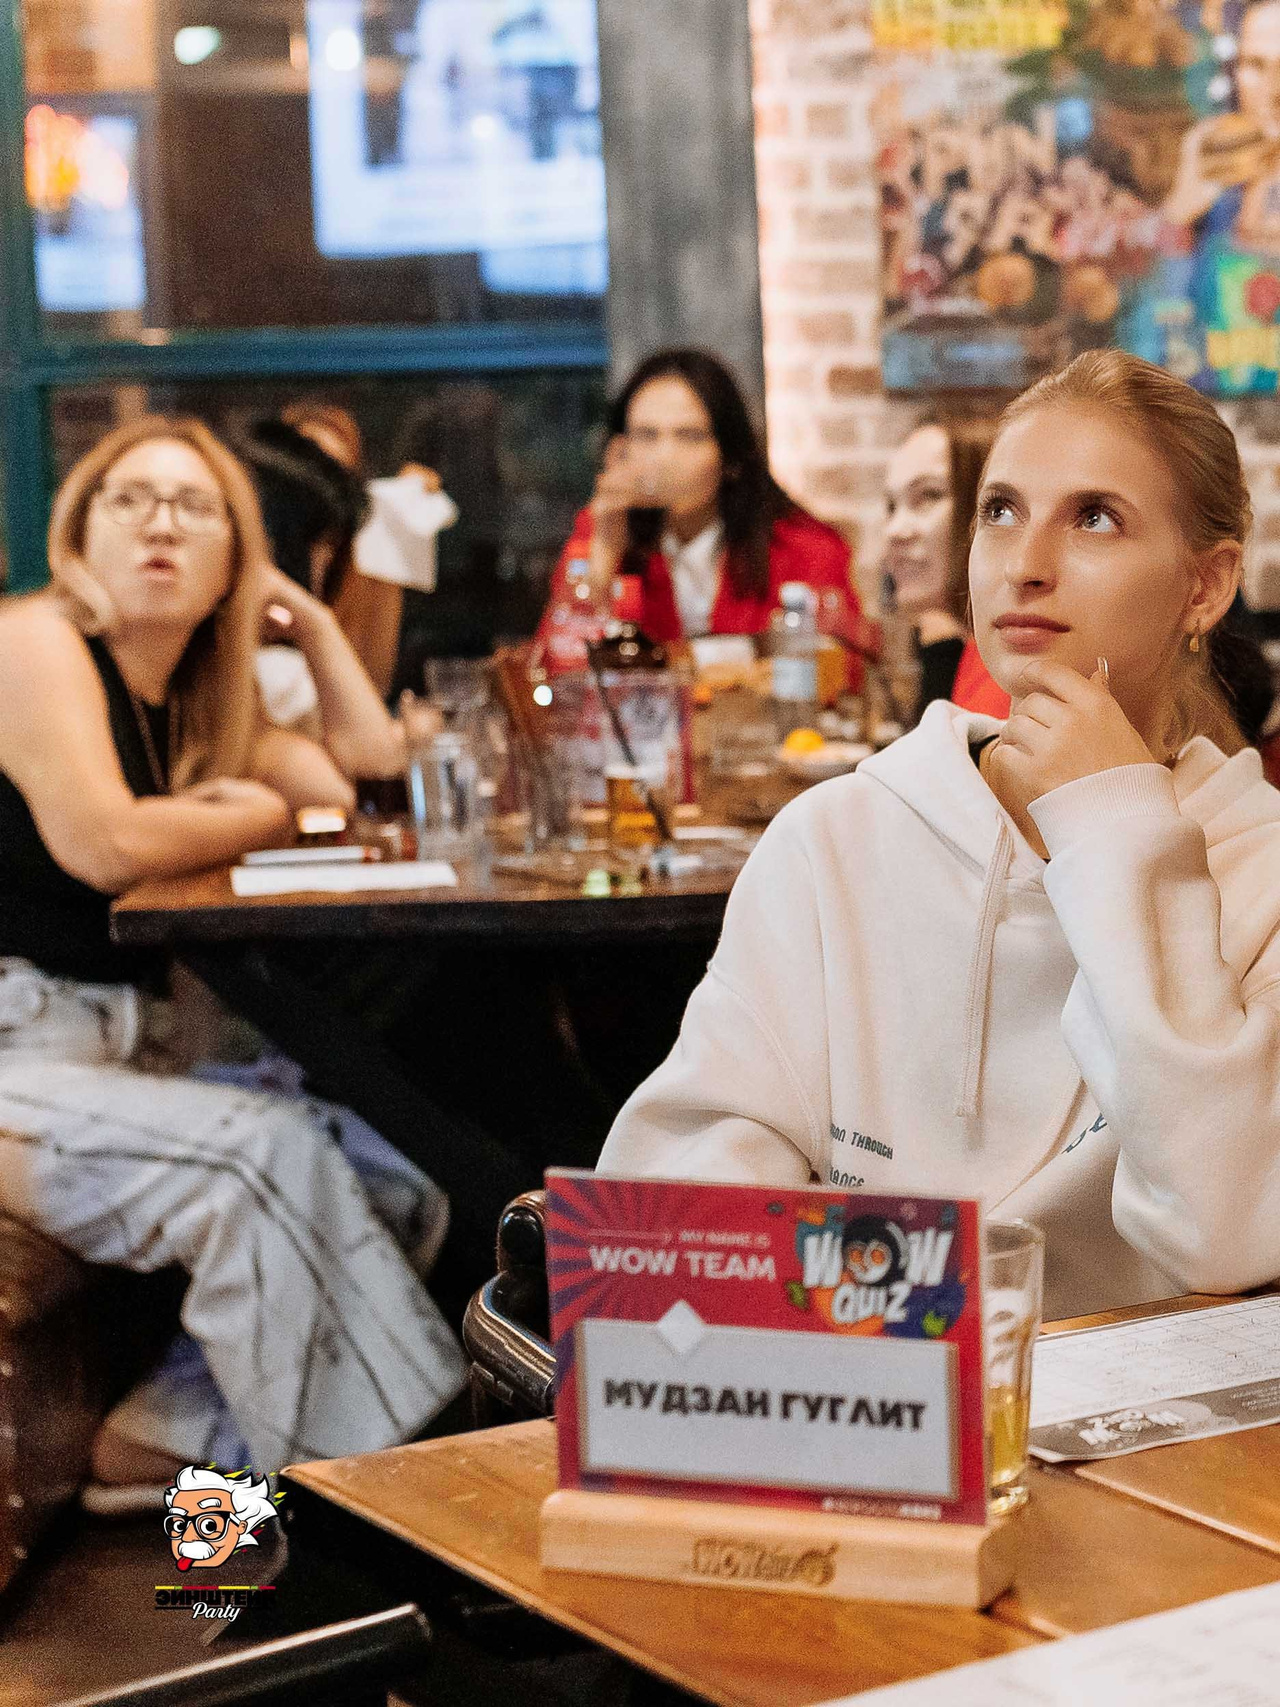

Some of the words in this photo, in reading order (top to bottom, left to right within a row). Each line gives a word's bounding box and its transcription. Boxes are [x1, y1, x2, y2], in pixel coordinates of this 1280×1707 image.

[851, 1131, 894, 1160] THROUGH
[589, 1245, 679, 1277] WOW
[683, 1249, 777, 1282] TEAM
[604, 1378, 770, 1419] МУДЗАН
[780, 1389, 927, 1432] ГУГЛИТ
